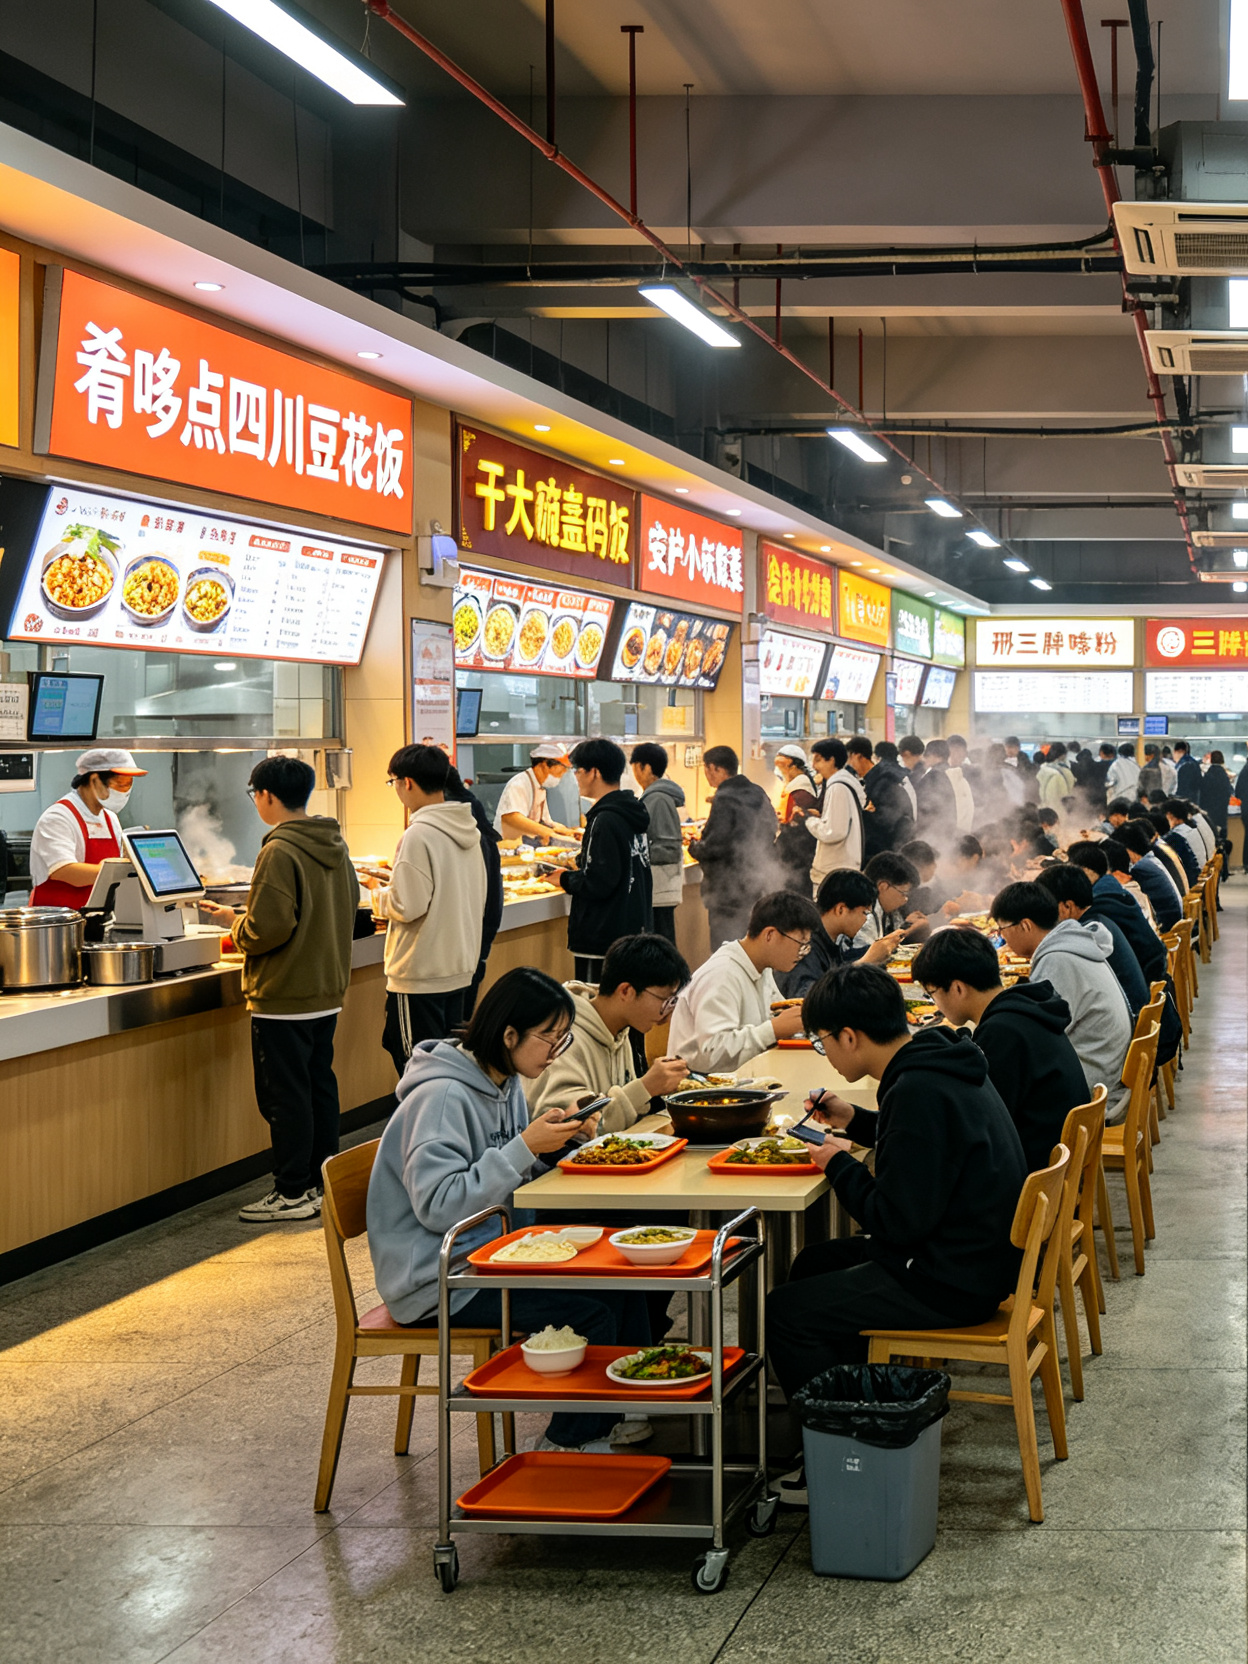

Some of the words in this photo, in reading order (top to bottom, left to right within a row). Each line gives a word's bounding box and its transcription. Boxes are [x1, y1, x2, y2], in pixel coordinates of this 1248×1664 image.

[74, 321, 404, 499] 肴哆点四川豆花饭
